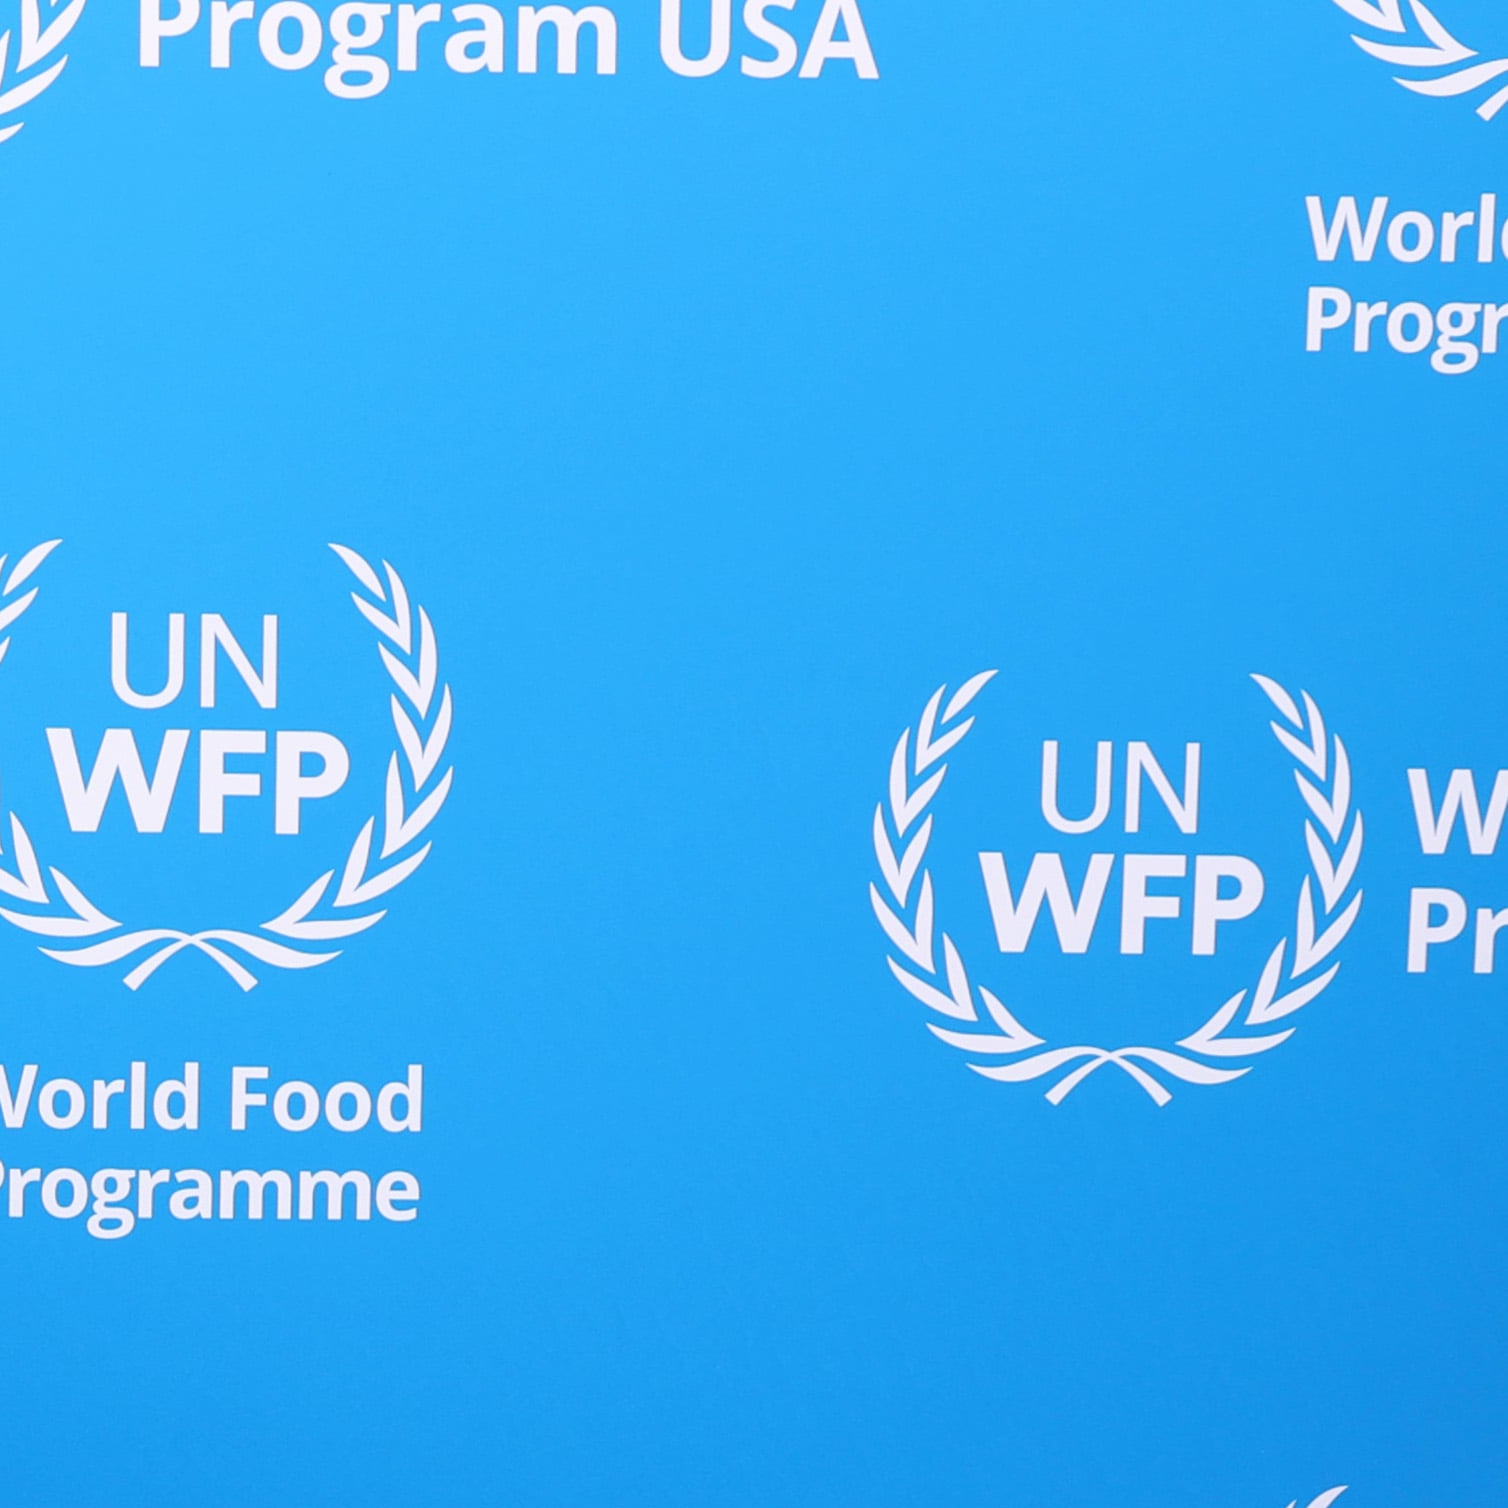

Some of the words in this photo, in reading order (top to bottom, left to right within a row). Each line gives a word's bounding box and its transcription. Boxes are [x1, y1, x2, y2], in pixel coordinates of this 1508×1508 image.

[139, 0, 617, 99] Program
[660, 0, 879, 79] USA
[1305, 193, 1508, 262] Worl
[111, 612, 278, 709] UN
[46, 728, 349, 834] WFP
[1041, 740, 1200, 834] UN
[979, 852, 1264, 955] WFP
[231, 1064, 422, 1132] Food
